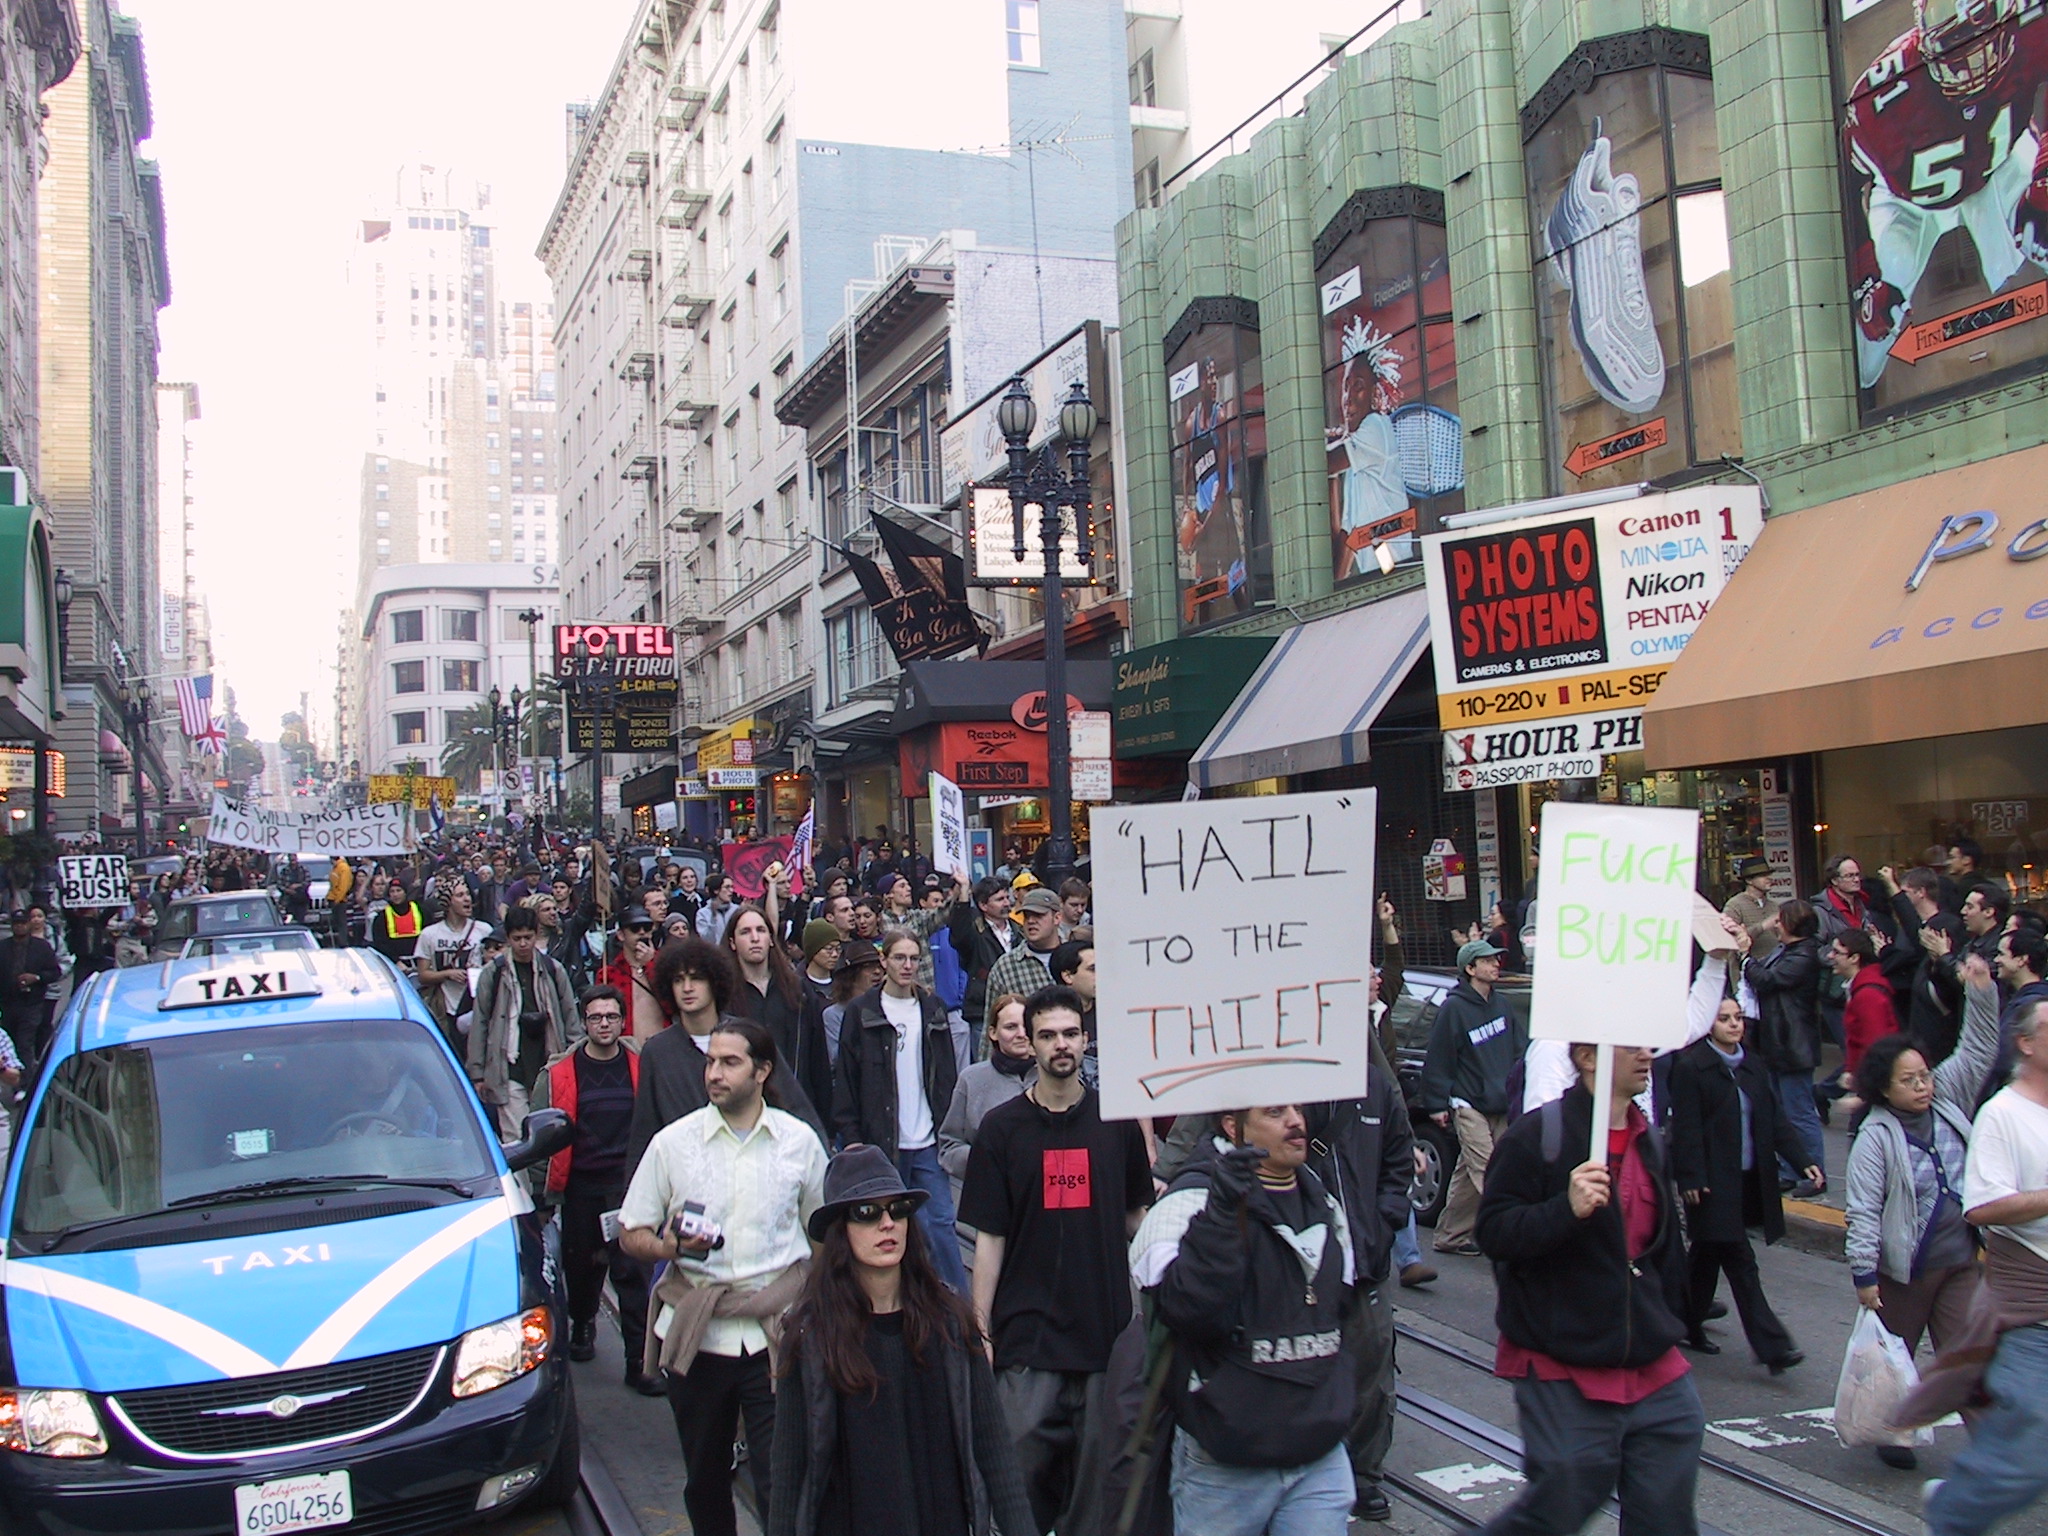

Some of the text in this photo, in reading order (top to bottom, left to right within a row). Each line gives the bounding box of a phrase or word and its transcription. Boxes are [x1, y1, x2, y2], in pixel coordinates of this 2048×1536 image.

[1912, 105, 2012, 206] 51
[1373, 275, 1414, 307] Reebok
[1916, 293, 2045, 351] First Step
[980, 509, 1033, 531] Gally
[1618, 508, 1702, 538] Canon
[1719, 507, 1738, 542] 1
[983, 530, 1014, 541] Dresde
[983, 543, 1011, 553] Meisse
[1452, 527, 1592, 601] PHOTO
[1621, 537, 1709, 569] MINOLTA
[1626, 570, 1705, 600] Nikon
[1459, 587, 1599, 659] SYSTEMS
[1628, 599, 1711, 631] PENTAX
[560, 626, 673, 655] HOTEL
[1631, 632, 1695, 657] OLYMP
[1117, 655, 1170, 695] Shanghai
[1462, 649, 1601, 680] CAMERAS & ELECTRONICS
[578, 729, 616, 738] DREDEN
[579, 719, 614, 728] LALQUE
[628, 729, 670, 738] FURNITURE
[630, 719, 667, 728] BRONZES
[967, 729, 1018, 741] Reebok
[631, 739, 668, 749] CARPETS
[1458, 733, 1478, 766] 1
[1482, 724, 1580, 763] HOUR
[711, 771, 721, 785] 1
[961, 762, 1024, 784] First Step
[1476, 762, 1543, 787] PASSPORT
[1548, 759, 1594, 778] PHOTO
[222, 796, 401, 828] WE WILL PROTECT
[234, 821, 401, 850] OUR FORESTS
[62, 857, 126, 879] FEAR
[1560, 832, 1695, 889] FUCK
[1769, 850, 1789, 863] JVC
[66, 879, 128, 900] BUSH
[1128, 922, 1308, 967] TO THE
[1558, 904, 1680, 965] BUSH
[198, 971, 288, 1000] TAXI
[1127, 979, 1362, 1060] THIEF
[1049, 1174, 1086, 1190] rage
[202, 1243, 331, 1275] TAXI
[260, 1481, 327, 1500] California
